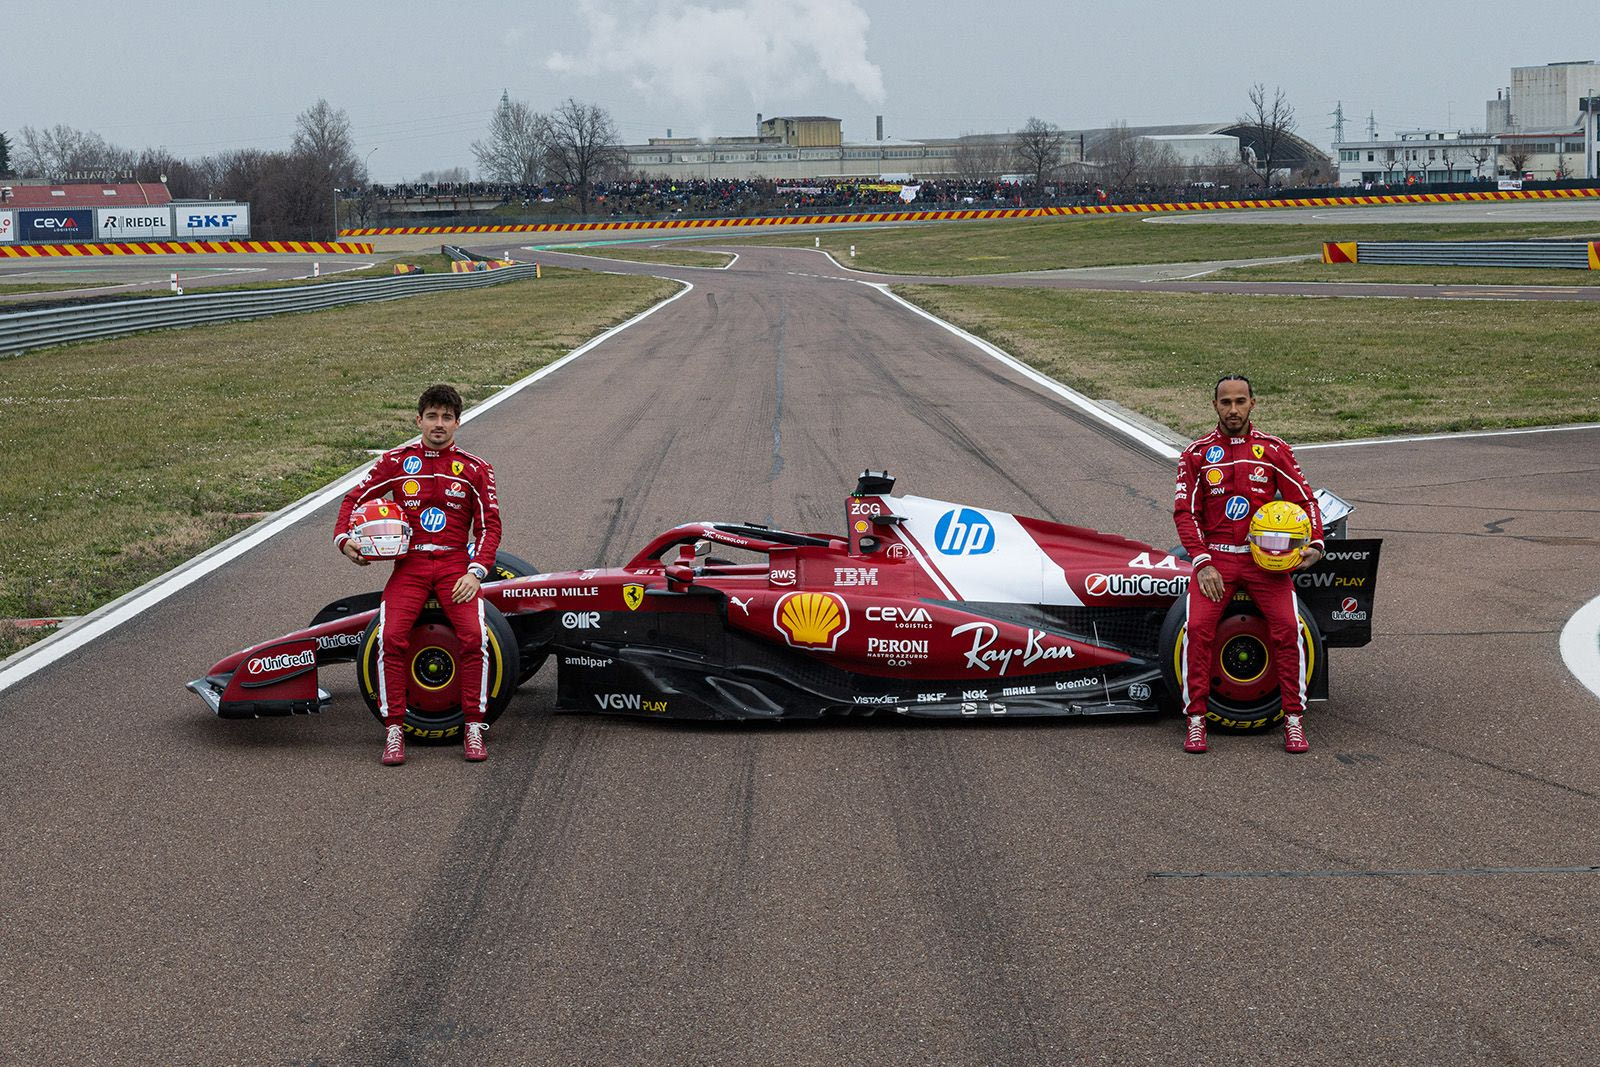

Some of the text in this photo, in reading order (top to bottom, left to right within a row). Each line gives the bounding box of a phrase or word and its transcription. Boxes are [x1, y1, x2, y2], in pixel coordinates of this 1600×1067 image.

[126, 217, 166, 228] RIEDEL
[187, 215, 237, 228] SKF
[1207, 446, 1224, 463] hp
[405, 457, 420, 474] hp
[1228, 497, 1247, 520] hp
[423, 508, 444, 531] hp
[941, 508, 990, 555] hp
[715, 533, 749, 545] TECHNOLOGY
[1128, 552, 1180, 570] 44
[770, 569, 796, 579] aws
[833, 567, 879, 586] IBM
[1109, 574, 1190, 595] UniCredit
[1335, 577, 1366, 587] PLAY
[503, 587, 599, 598] RICHARD MILLE
[1332, 610, 1367, 621] UniCredit
[320, 631, 364, 649] UniCred
[867, 637, 929, 653] PERONI
[262, 649, 315, 671] UniCredit
[1056, 677, 1098, 690] brembo
[1129, 684, 1149, 697] FIA
[917, 693, 946, 702] SKF
[962, 689, 988, 700] NGK
[1003, 686, 1036, 697] MAHLE
[594, 693, 668, 712] VGW PLAY
